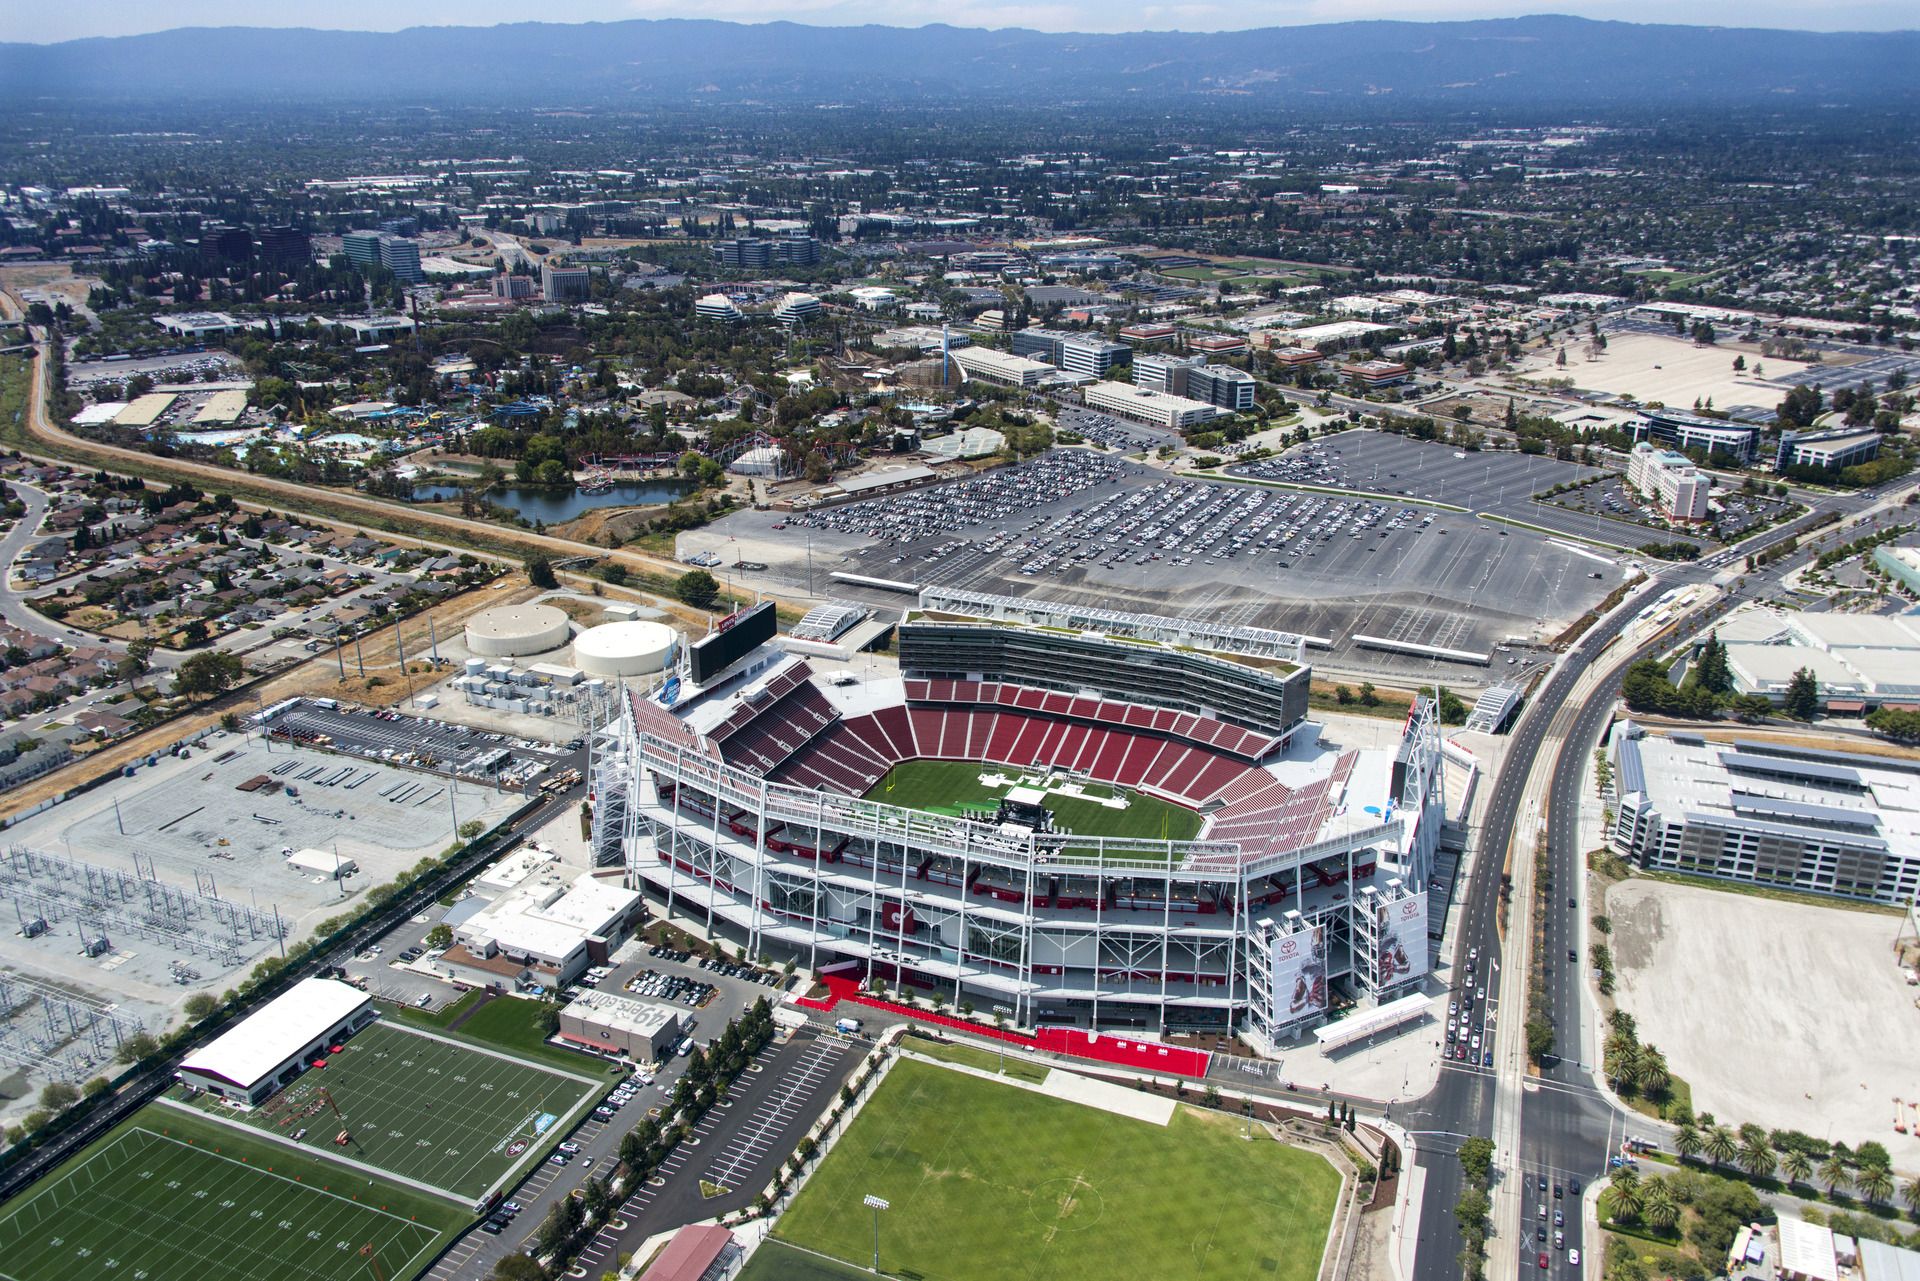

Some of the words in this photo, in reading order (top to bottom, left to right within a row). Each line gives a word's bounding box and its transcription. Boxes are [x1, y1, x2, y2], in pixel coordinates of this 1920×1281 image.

[1400, 911, 1420, 922] TOYOTA
[1278, 951, 1300, 962] TOYOTA
[588, 991, 666, 1027] 49ers.com
